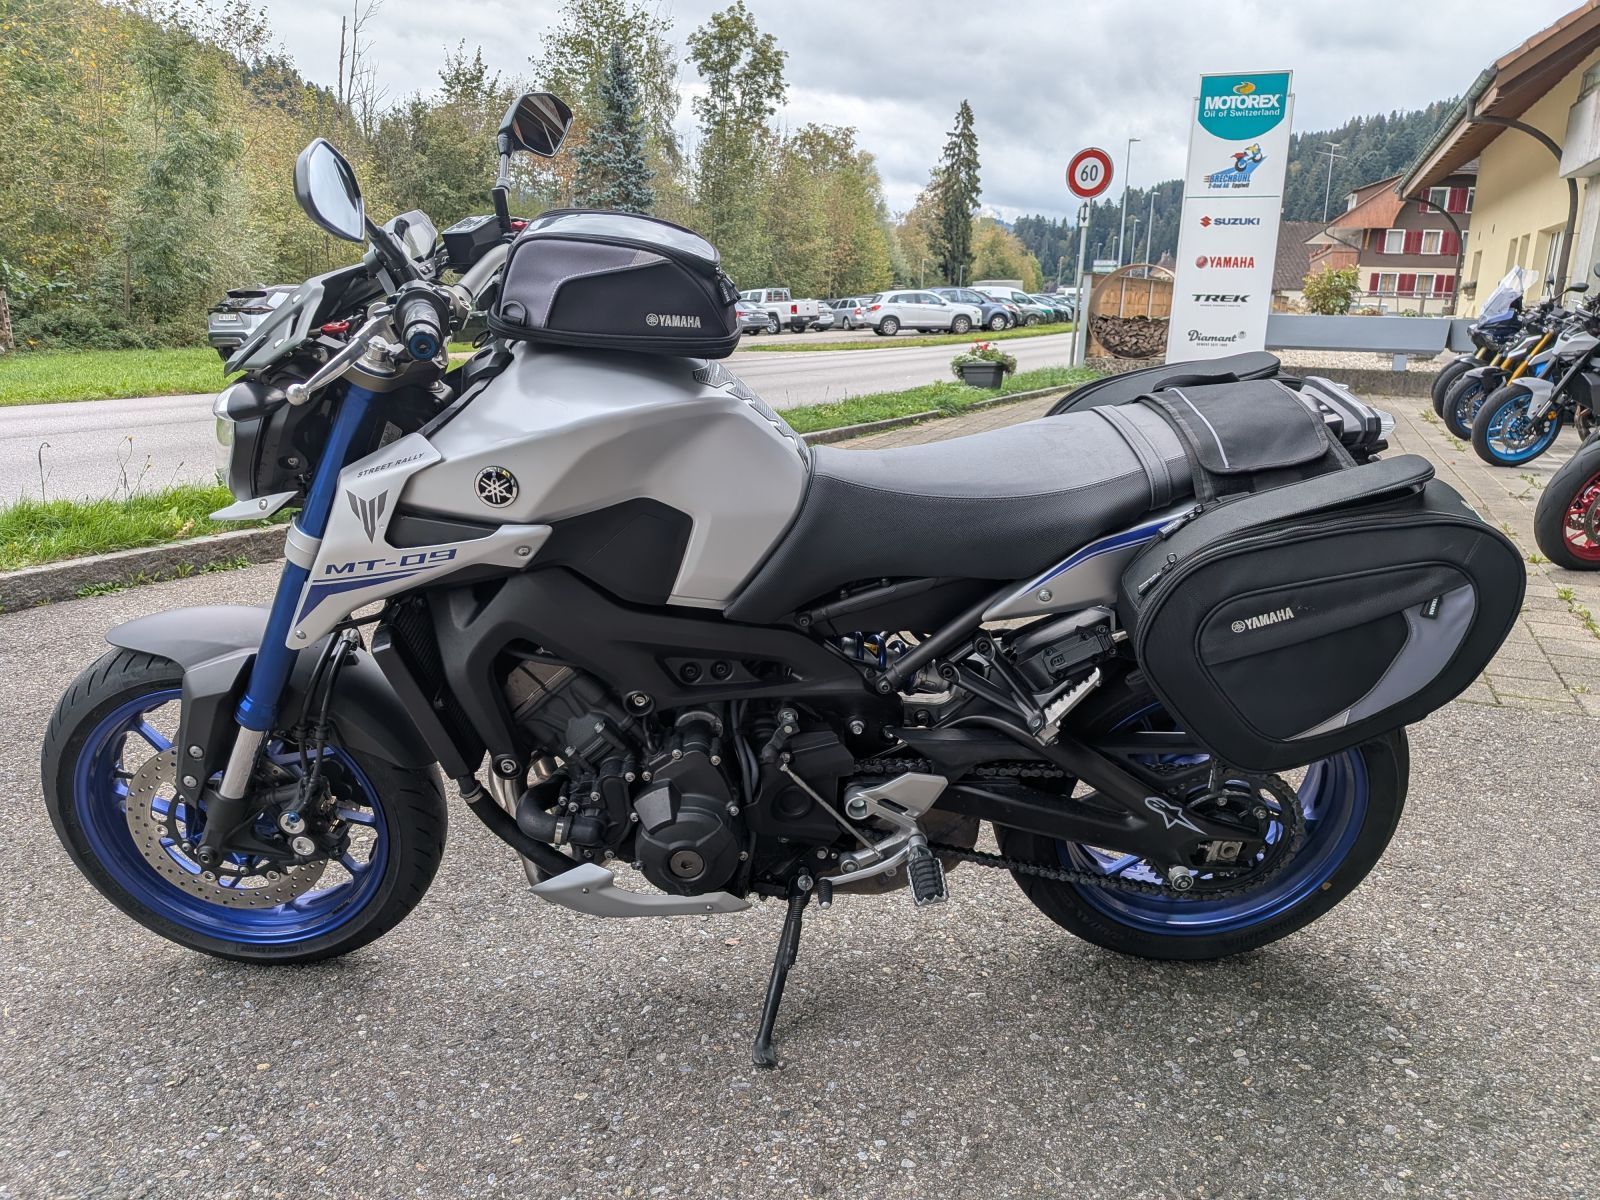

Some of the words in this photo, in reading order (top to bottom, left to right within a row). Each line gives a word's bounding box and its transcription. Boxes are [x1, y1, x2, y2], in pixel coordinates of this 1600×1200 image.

[1205, 94, 1280, 110] MOTOREX
[1204, 110, 1216, 118] Oil
[1230, 108, 1280, 117] Switzerland
[1081, 164, 1099, 182] 60
[1213, 217, 1260, 226] SUZUKI
[1209, 256, 1255, 268] YAMAHA
[1192, 294, 1251, 303] TREK
[659, 314, 702, 329] YAMAHA
[1188, 329, 1237, 343] Diamant
[357, 461, 393, 478] STREET
[394, 452, 425, 466] RALLY
[325, 548, 457, 575] MT-09
[1244, 607, 1295, 630] YAMAHA
